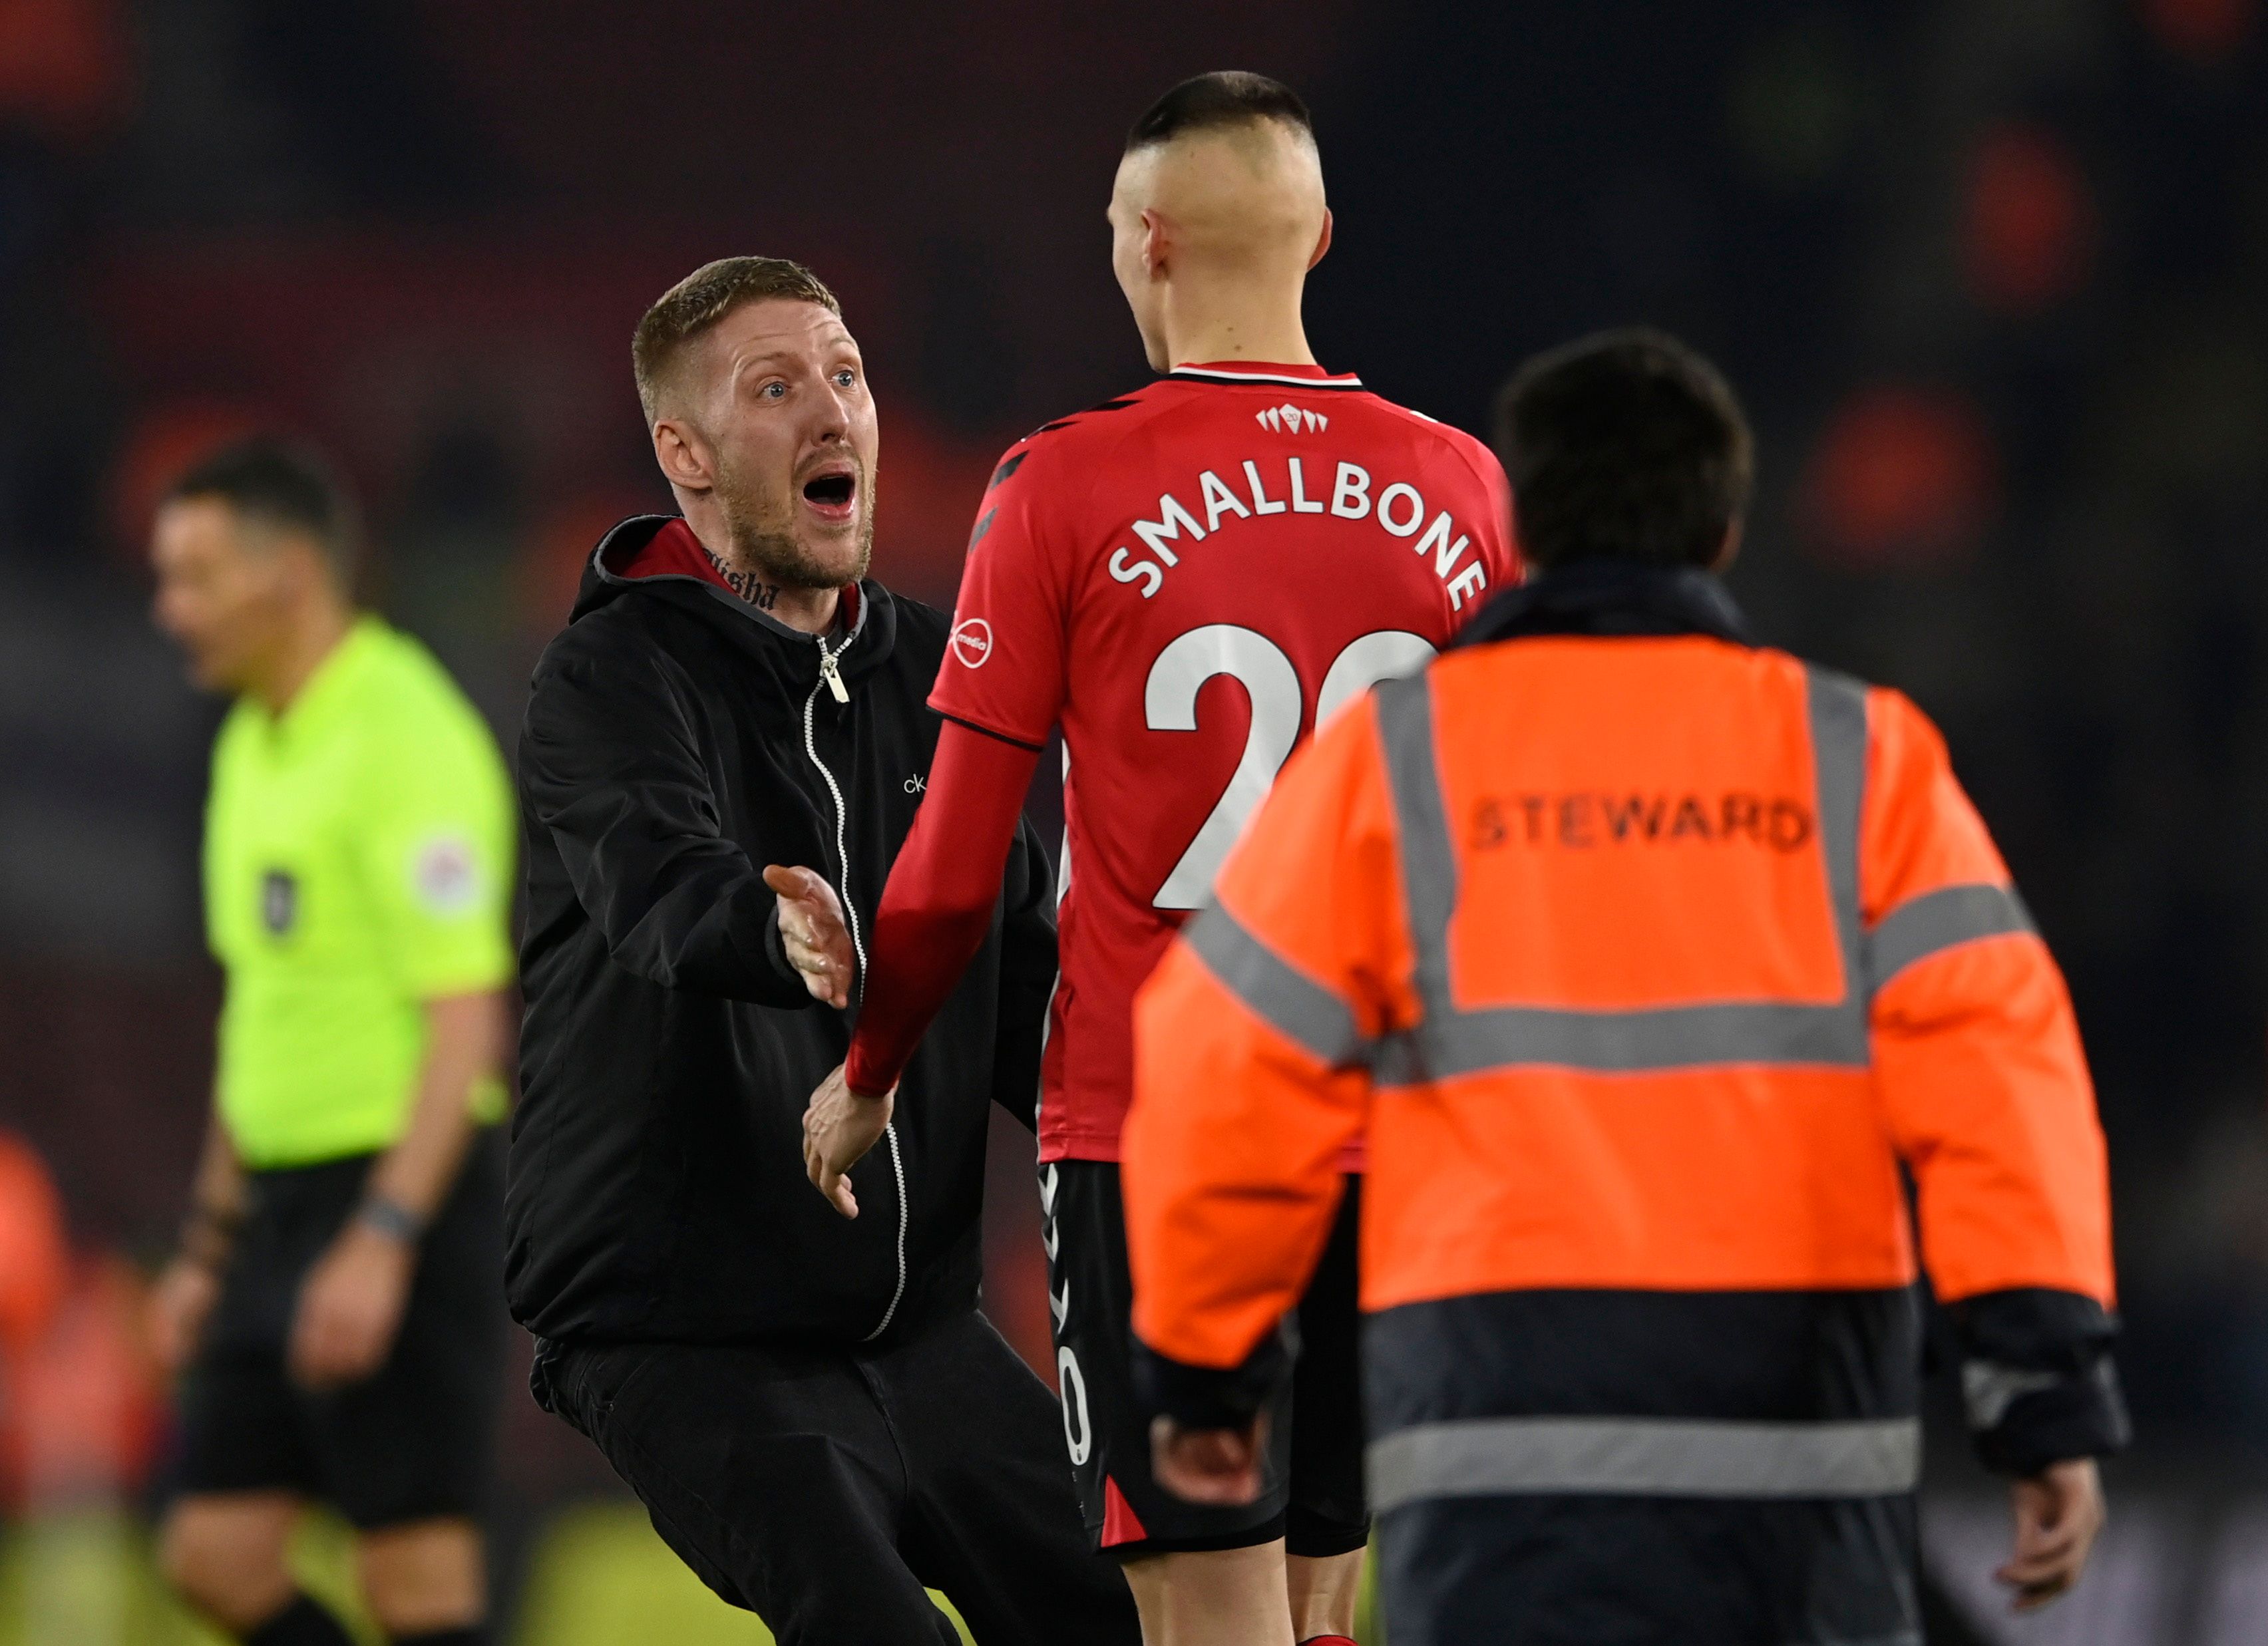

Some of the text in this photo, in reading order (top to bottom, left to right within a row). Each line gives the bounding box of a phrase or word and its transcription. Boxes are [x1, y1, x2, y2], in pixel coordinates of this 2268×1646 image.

[1285, 413, 1298, 422] 20
[1109, 457, 1487, 612] SMALLBONE
[957, 633, 987, 651] media
[904, 773, 927, 794] ck
[1467, 789, 1815, 855] STEWARD
